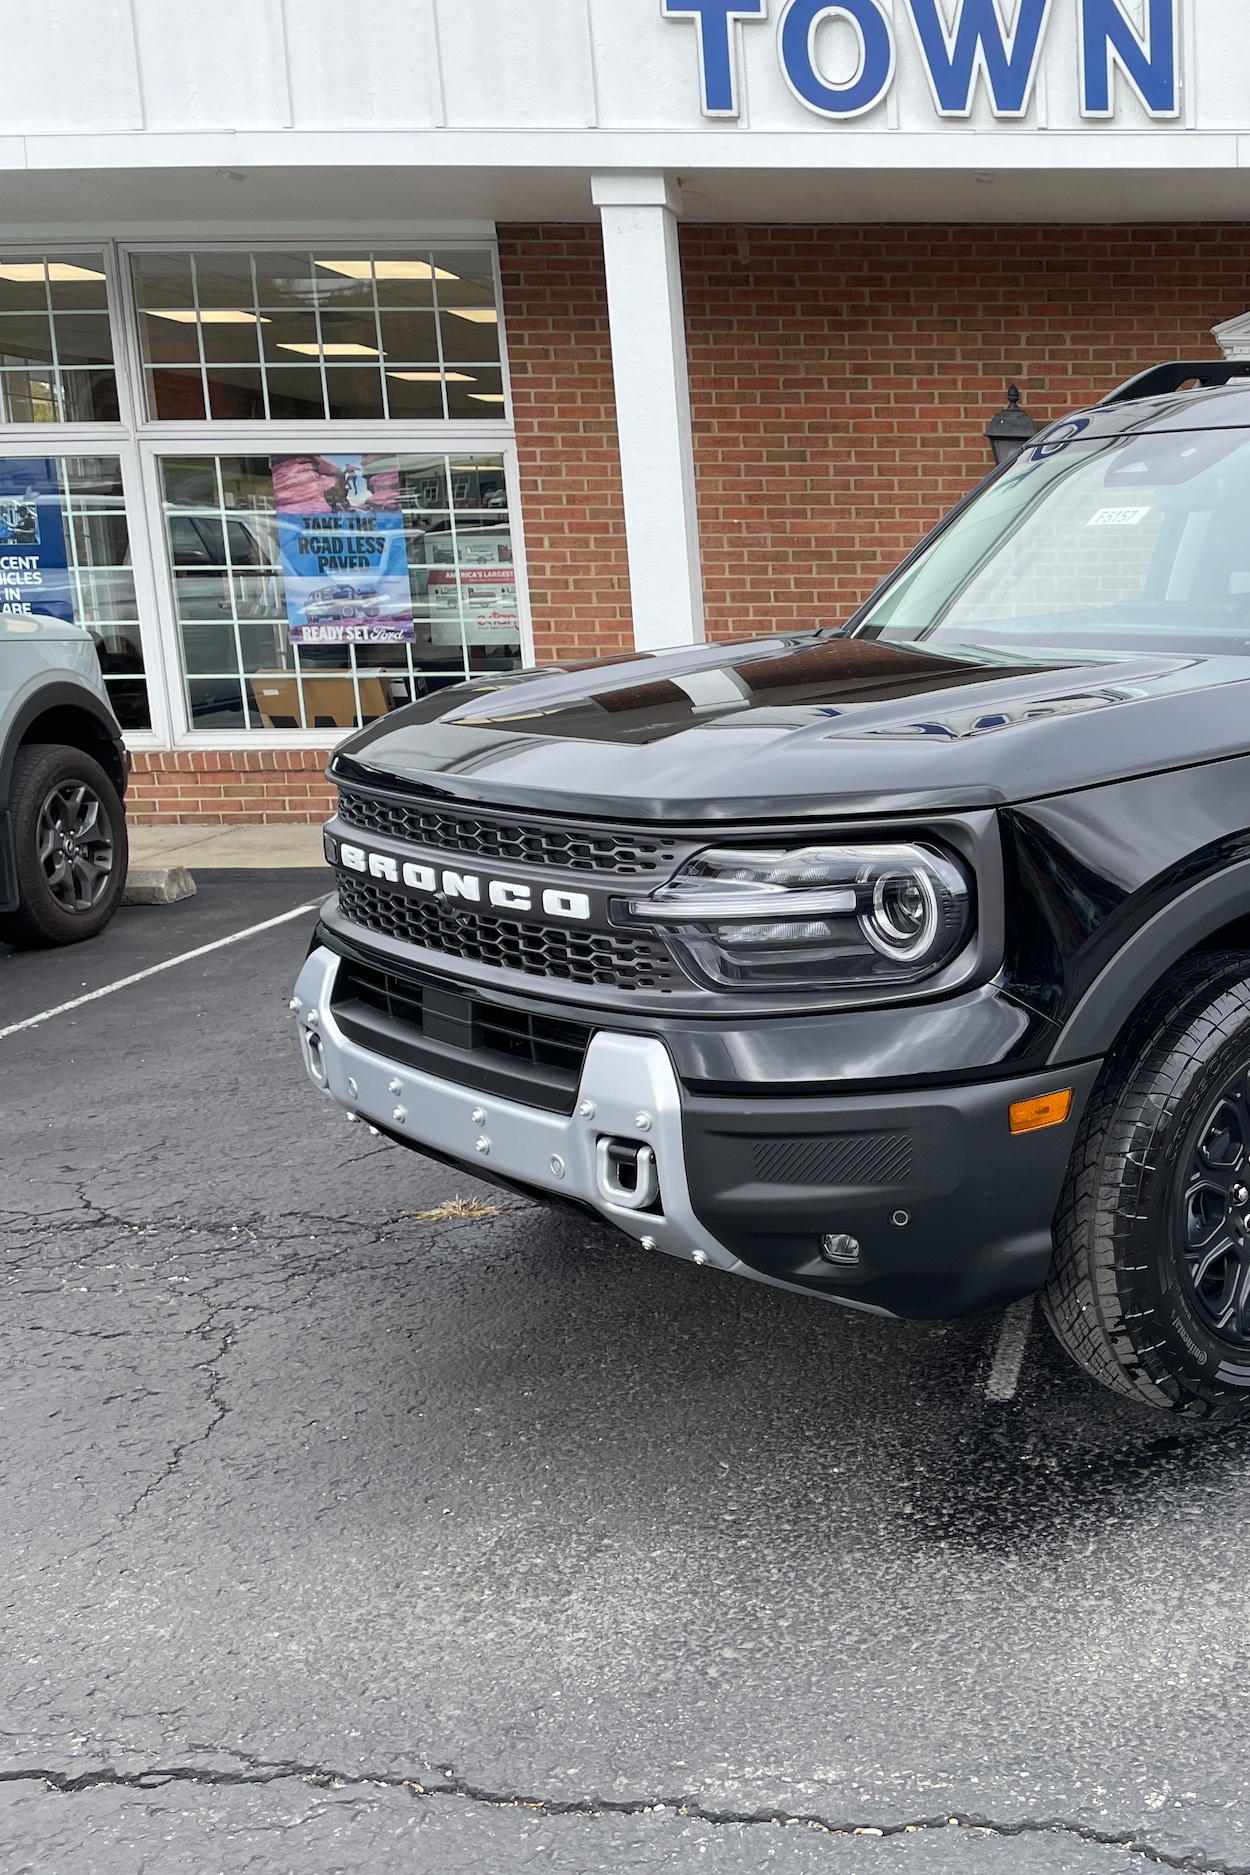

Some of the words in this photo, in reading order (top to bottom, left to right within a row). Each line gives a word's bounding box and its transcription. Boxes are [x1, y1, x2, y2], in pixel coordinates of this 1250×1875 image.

[661, 0, 1183, 121] TOWN
[302, 517, 342, 534] TAKE
[345, 516, 377, 533] THE
[1094, 510, 1139, 524] F5157
[298, 537, 344, 555] ROAD
[347, 536, 386, 554] LESS
[318, 555, 370, 574] PAVED
[302, 626, 344, 641] READY
[345, 625, 370, 641] SET
[370, 625, 405, 641] Ford
[340, 843, 591, 920] BRONCO
